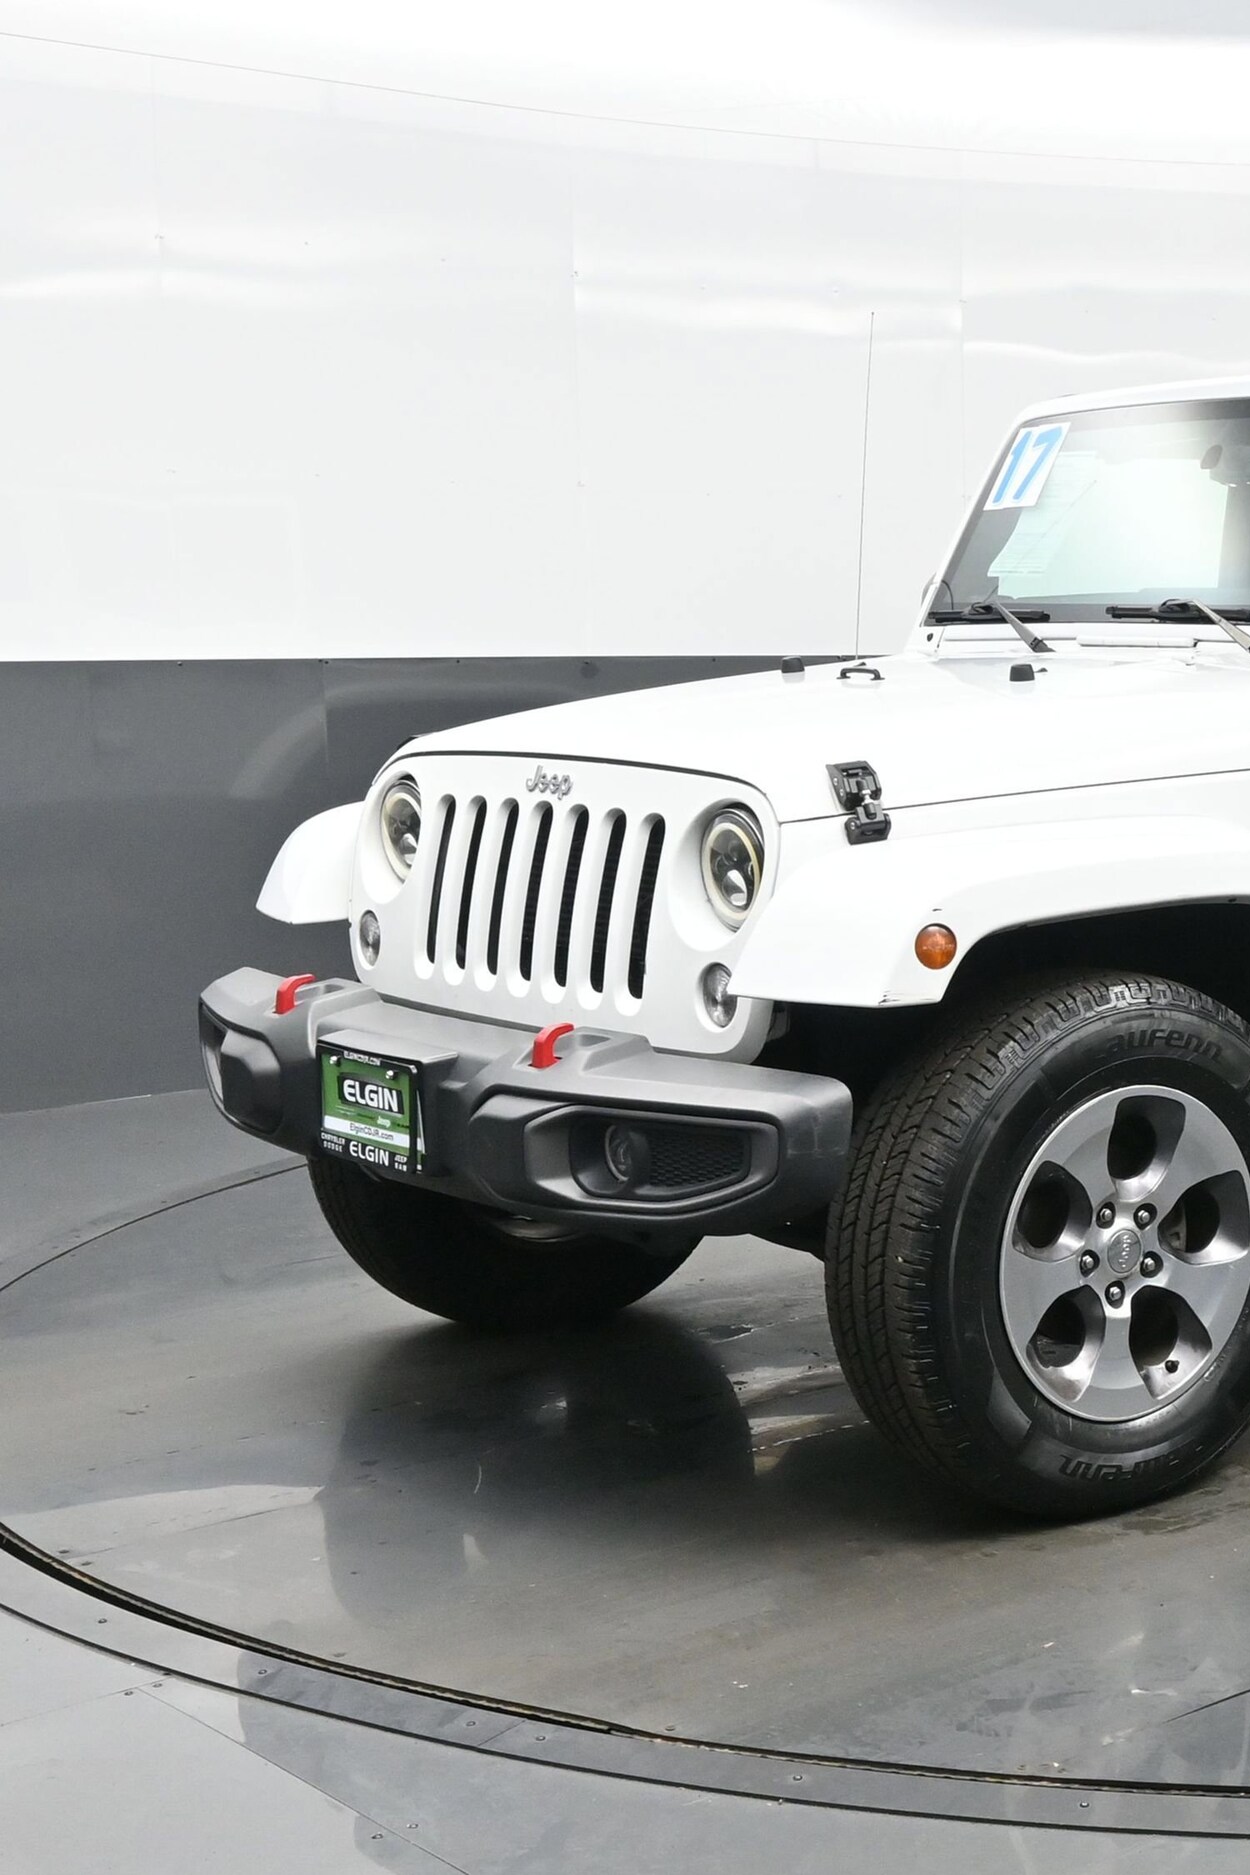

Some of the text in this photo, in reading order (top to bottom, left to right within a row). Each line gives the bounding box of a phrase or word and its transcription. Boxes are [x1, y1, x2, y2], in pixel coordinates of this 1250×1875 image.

[991, 425, 1063, 505] 17
[525, 764, 574, 801] Jeep
[343, 1078, 399, 1113] ELGIN
[349, 1121, 394, 1142] ElginCDJR.com
[348, 1140, 390, 1167] ELGIN
